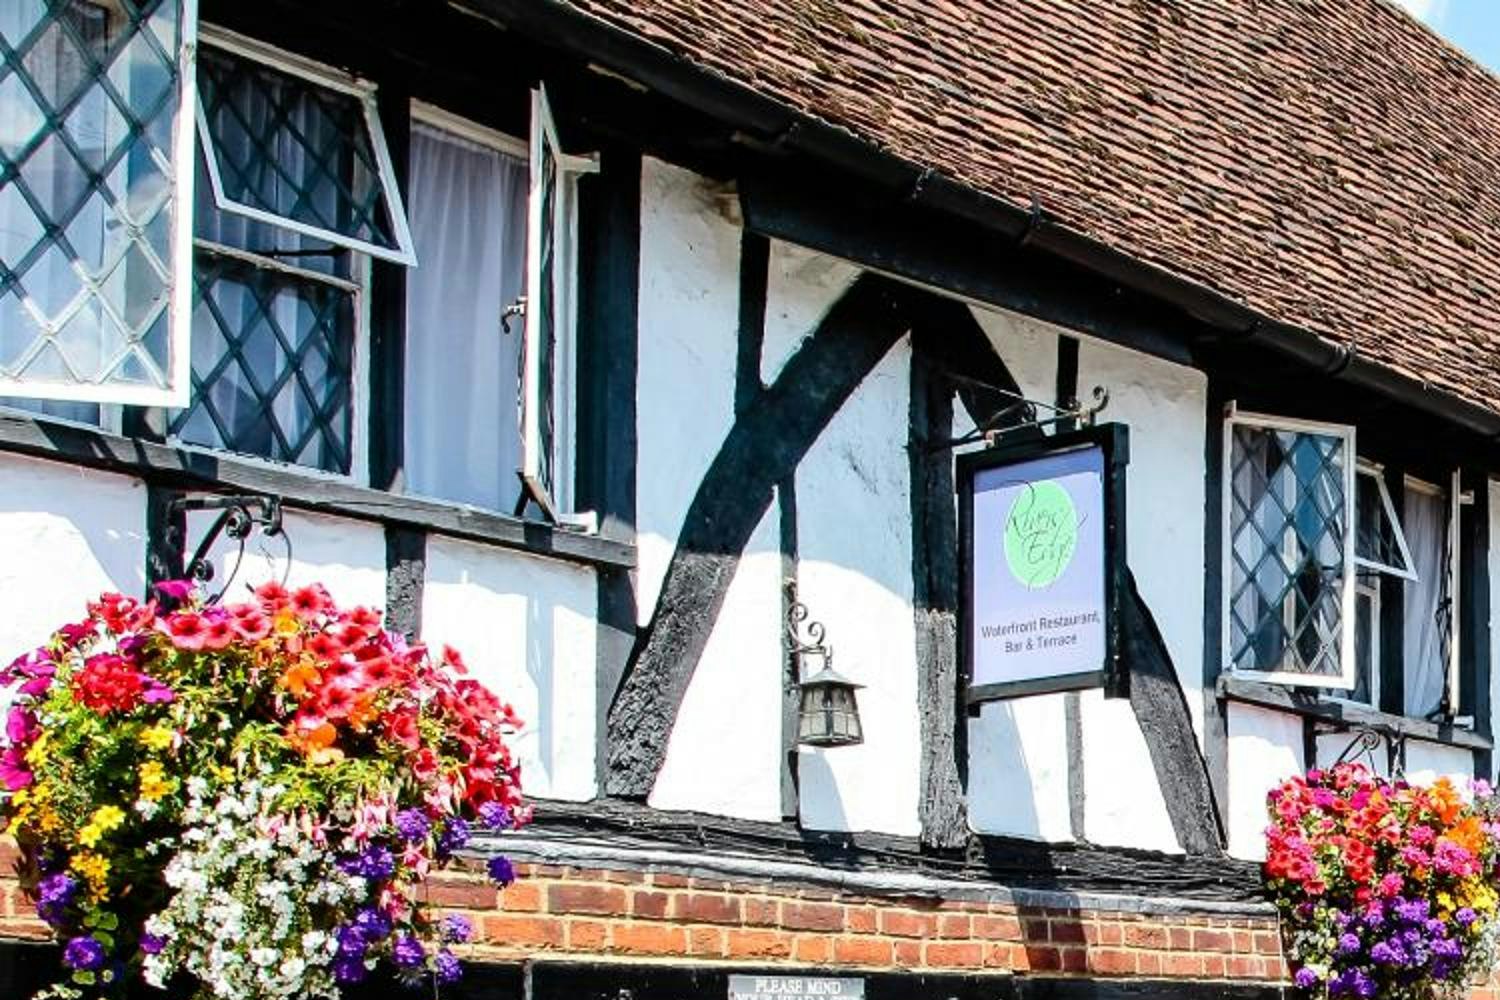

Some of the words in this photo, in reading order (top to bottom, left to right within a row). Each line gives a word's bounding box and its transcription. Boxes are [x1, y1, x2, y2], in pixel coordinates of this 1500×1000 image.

[981, 620, 1037, 638] Waterfront
[1005, 641, 1022, 653] Bar
[1025, 638, 1034, 651] &
[1038, 634, 1077, 649] Terrace
[755, 979, 802, 993] PLEASE
[807, 981, 841, 995] MIND
